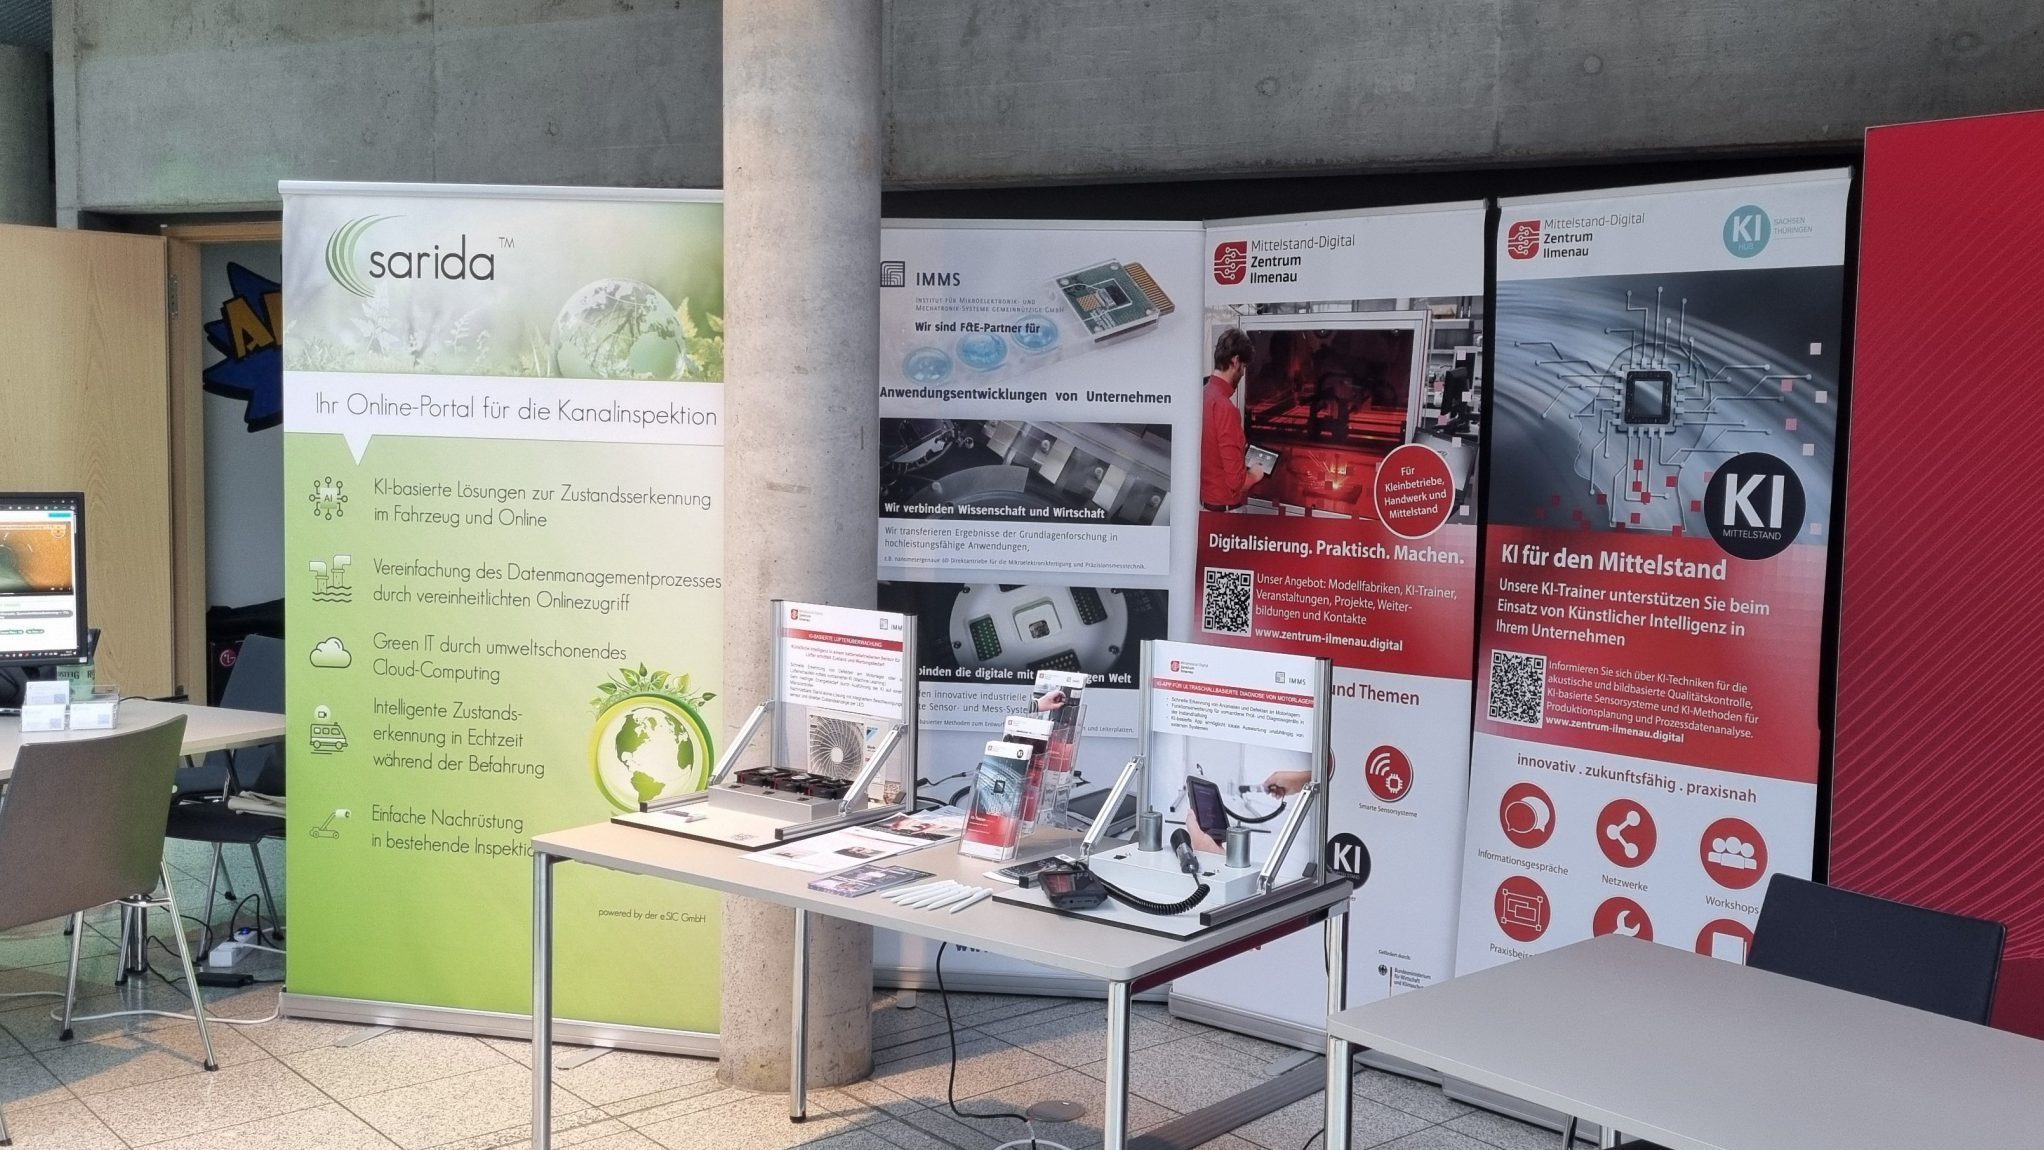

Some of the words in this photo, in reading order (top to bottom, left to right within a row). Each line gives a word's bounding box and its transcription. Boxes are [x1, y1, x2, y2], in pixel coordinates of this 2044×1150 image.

[1545, 213, 1644, 229] Mittelstand-Digital
[1732, 214, 1760, 243] KI
[1774, 217, 1805, 225] SACHSEN
[1774, 225, 1812, 234] THÜRINGEN
[1251, 234, 1355, 251] Mittelstand-Digital
[1544, 232, 1593, 244] Zentrum
[369, 235, 495, 280] sarida
[1251, 255, 1301, 268] Zentrum
[1544, 247, 1589, 258] Ilmenau
[916, 272, 960, 286] IMMS
[1250, 272, 1297, 283] Ilmenau
[915, 322, 931, 332] Wir
[935, 322, 956, 332] sind
[960, 323, 1022, 333] F&E-Partner
[1025, 323, 1040, 334] für
[880, 387, 1047, 403] Anwendungsentwicklungen
[1056, 392, 1077, 401] von
[1086, 391, 1172, 404] Unternehmen
[316, 392, 338, 415] Ihr
[347, 393, 474, 419] Online-Portal
[483, 396, 510, 420] für
[518, 398, 550, 421] die
[559, 400, 717, 429] Kanalinspektion
[1401, 467, 1414, 475] Für
[374, 478, 452, 498] KI-basierte
[457, 481, 526, 502] Lösungen
[532, 488, 555, 501] zur
[561, 484, 711, 509] Zustandsserkennung
[1385, 477, 1444, 492] Kleinbetriebe,
[1385, 493, 1427, 506] Handwerk
[1429, 490, 1446, 500] und
[1724, 473, 1785, 529] KI
[375, 508, 389, 521] im
[394, 506, 460, 527] Fahrzeug
[466, 508, 493, 525] und
[499, 509, 547, 527] Online
[885, 503, 900, 512] Wir
[904, 503, 954, 514] verbinden
[958, 504, 1025, 516] Wissenschaft
[1030, 506, 1049, 516] und
[1054, 507, 1104, 518] Wirtschaft
[1390, 505, 1438, 519] Mittelstand
[885, 527, 897, 535] Wir
[900, 527, 951, 537] transferieren
[956, 529, 999, 539] Ergebnisse
[1003, 530, 1016, 538] der
[1020, 530, 1106, 542] Grundlagenforschung
[1110, 532, 1118, 541] in
[1723, 529, 1781, 540] MITTELSTAND
[885, 539, 965, 551] hochleistungsfähige
[968, 541, 1030, 552] Anwendungen,
[1209, 534, 1312, 558] Digitalisierung.
[1317, 541, 1389, 560] Praktisch.
[1394, 545, 1464, 565] Machen.
[1502, 544, 1518, 563] KI
[1522, 544, 1549, 565] für
[1554, 547, 1593, 570] den
[1600, 551, 1726, 580] Mittelstand
[374, 558, 470, 582] Vereinfachung
[476, 563, 502, 580] des
[508, 563, 721, 589] Datenmanagementprozesses
[1257, 574, 1282, 585] Unser
[1285, 576, 1326, 589] Angebot:
[1329, 578, 1403, 595] Modellfabriken,
[1405, 585, 1457, 599] KI-Trainer,
[1499, 578, 1538, 594] Unsere
[1541, 582, 1606, 600] KI-Trainer
[1610, 588, 1699, 609] unterstützen
[1704, 596, 1725, 611] Sie
[1730, 598, 1769, 615] beim
[373, 584, 411, 602] durch
[417, 587, 530, 607] vereinheitlichten
[537, 591, 630, 614] Onlinezugriff
[1257, 590, 1332, 606] Veranstaltungen,
[1334, 595, 1375, 610] Projekte,
[1377, 600, 1412, 612] Weiter-
[1256, 605, 1300, 620] bildungen
[1302, 609, 1321, 620] und
[1323, 612, 1366, 625] Kontakte
[1498, 599, 1537, 615] Einsatz
[1540, 606, 1564, 618] von
[1569, 606, 1646, 626] Künstlicher
[1650, 613, 1727, 635] Intelligenz
[1731, 621, 1745, 636] in
[1255, 628, 1402, 651] www.zentrum-ilmenau.digital
[1496, 619, 1528, 635] Ihrem
[1532, 624, 1625, 646] Unternehmen
[374, 633, 419, 651] Green
[424, 635, 434, 651] IT
[440, 635, 480, 655] durch
[486, 639, 626, 660] umweltschonendes
[373, 659, 500, 683] Cloud-Computing
[955, 667, 971, 677] die
[975, 667, 1013, 680] digitale
[1017, 669, 1033, 679] mit
[1108, 674, 1131, 683] Welt
[1549, 661, 1599, 676] Informieren
[1601, 666, 1613, 677] Sie
[1615, 668, 1632, 679] sich
[1634, 670, 1655, 681] über
[1657, 672, 1714, 689] KI-Techniken
[1716, 680, 1731, 691] für
[1733, 682, 1747, 693] die
[935, 689, 977, 700] innovative
[980, 691, 1027, 701] industrielle
[1359, 684, 1419, 705] Themen
[1548, 675, 1592, 688] akustische
[1595, 680, 1611, 690] und
[1613, 681, 1665, 697] bildbasierte
[1668, 688, 1753, 710] Qualitätskontrolle,
[374, 698, 447, 720] Intelligente
[453, 702, 522, 722] Zustands-
[930, 703, 960, 712] Sensor-
[1547, 688, 1593, 702] KI-basierte
[1595, 693, 1659, 711] Sensorsysteme
[1661, 703, 1679, 714] und
[1681, 705, 1742, 722] KI-Methoden
[1744, 713, 1758, 724] für
[1546, 717, 1684, 743] www.zentrum-ilmenau.digital
[1547, 702, 1633, 724] Produktionsplanung
[1635, 714, 1653, 723] und
[1655, 717, 1753, 739] Prozessdatenanalyse.
[374, 729, 445, 747] erkennung
[452, 731, 462, 744] in
[468, 731, 523, 747] Echtzeit
[373, 754, 432, 770] während
[438, 756, 463, 771] der
[469, 756, 544, 779] Befahrung
[1518, 754, 1576, 773] innovativ
[1585, 765, 1675, 792] zukunftsfähig
[1687, 782, 1757, 803] praxisnah
[372, 804, 425, 824] Einfache
[432, 809, 523, 833] Nachrüstung
[1359, 803, 1376, 812] Smarte
[1378, 806, 1417, 818] Sensorsysteme
[372, 834, 381, 847] in
[386, 834, 469, 854] bestehende
[1334, 842, 1360, 874] KI
[1478, 848, 1569, 875] Informationsgespräche
[1602, 874, 1648, 891] Netzwerke
[599, 908, 631, 917] powered
[633, 909, 643, 919] by
[645, 910, 658, 920] der
[681, 913, 706, 922] GmbH
[1706, 896, 1759, 915] Workshops
